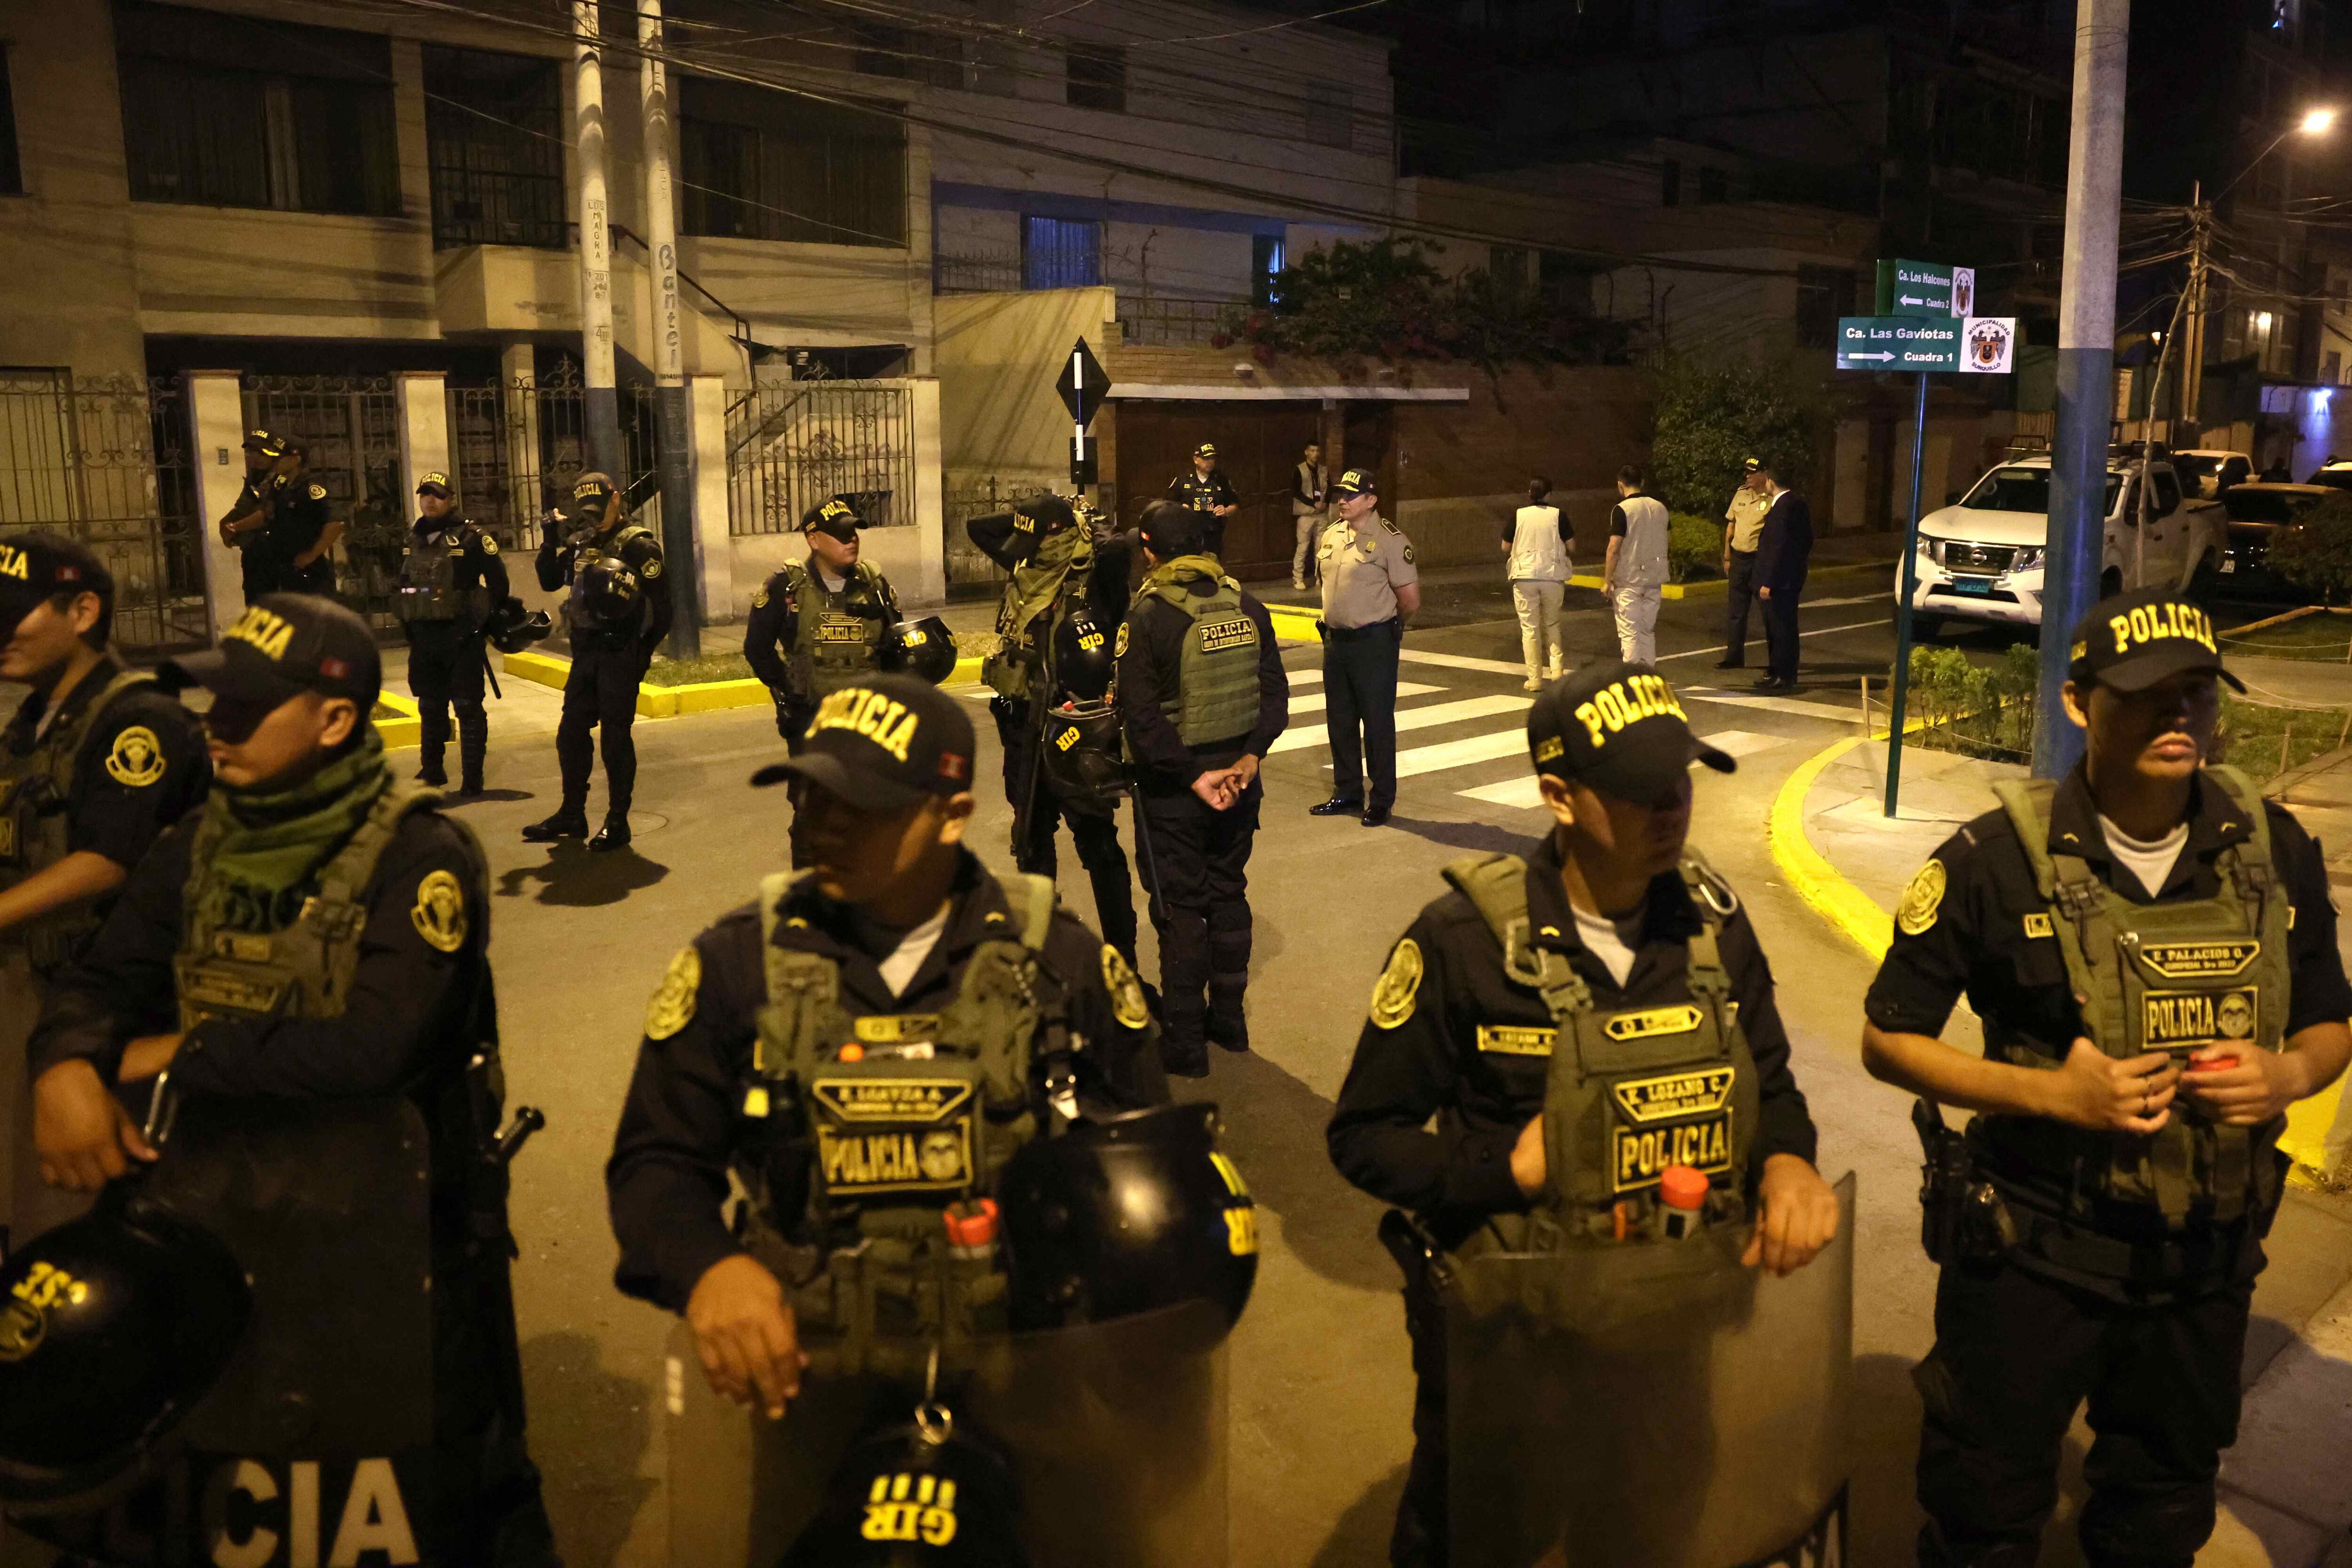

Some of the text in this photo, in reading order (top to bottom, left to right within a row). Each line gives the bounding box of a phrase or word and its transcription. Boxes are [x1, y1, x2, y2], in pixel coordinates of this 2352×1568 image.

[1899, 269, 1909, 281] Ca.
[1910, 271, 1922, 283] Los
[1923, 272, 1950, 287] Halcones
[1926, 297, 1949, 309] Cuadra 2
[1846, 328, 1954, 339] Ca. Las Gaviotas
[1968, 319, 2010, 336] MUNICIPALIDAD
[1904, 351, 1953, 362] Cuadra 1
[1971, 362, 2001, 371] SURQUILLO
[1201, 621, 1251, 640] POLICIA
[2109, 602, 2217, 654] POLICIA
[1078, 633, 1104, 650] GIR
[1056, 726, 1081, 751] GIR
[2147, 996, 2216, 1039] POLICIA
[825, 1133, 921, 1183] POLICIA
[1621, 1121, 1727, 1180] POLICIA
